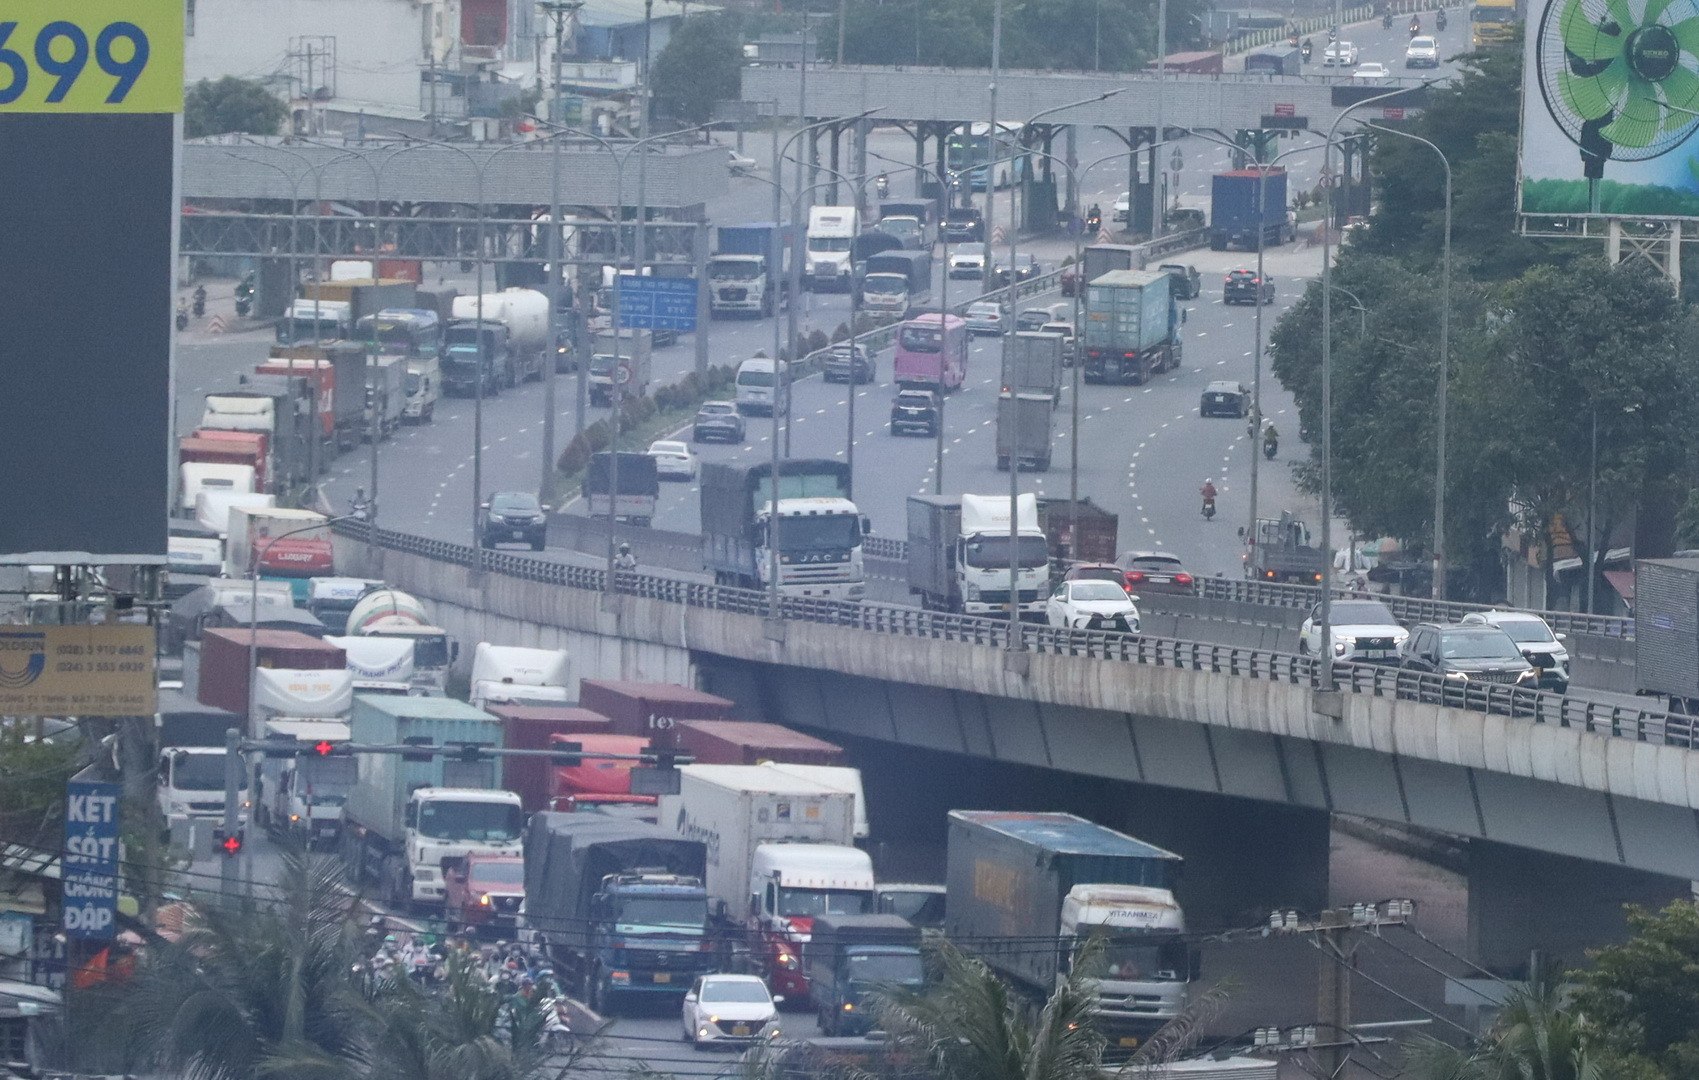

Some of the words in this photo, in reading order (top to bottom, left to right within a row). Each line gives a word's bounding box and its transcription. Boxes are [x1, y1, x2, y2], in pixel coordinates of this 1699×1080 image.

[0, 21, 149, 104] 699
[801, 554, 832, 562] JAC
[68, 789, 116, 823] KÉT
[66, 826, 115, 864] SẮT
[63, 901, 112, 936] ĐẬP
